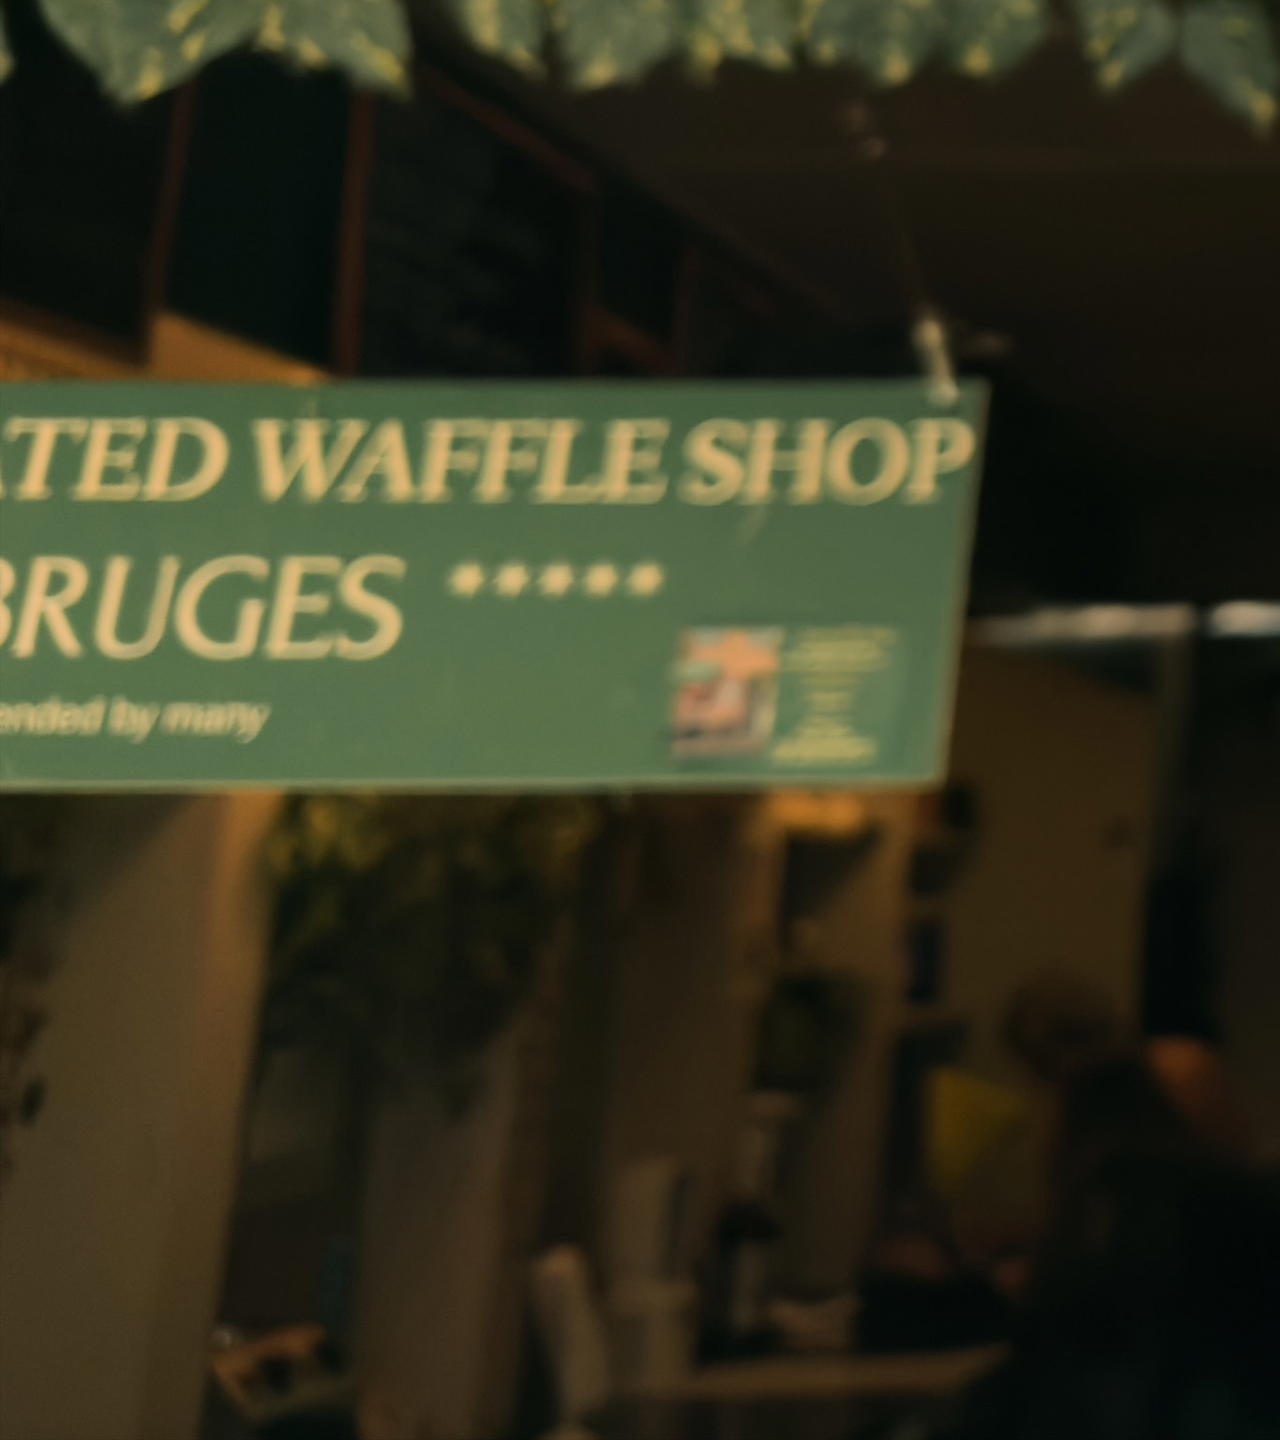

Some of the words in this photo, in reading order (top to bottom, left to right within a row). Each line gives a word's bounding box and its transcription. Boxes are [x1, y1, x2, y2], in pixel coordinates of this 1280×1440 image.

[0, 416, 230, 502] TED
[252, 417, 671, 503] WAFFLE
[677, 416, 977, 507] SHOP
[108, 695, 160, 744] by
[158, 701, 272, 744] many
